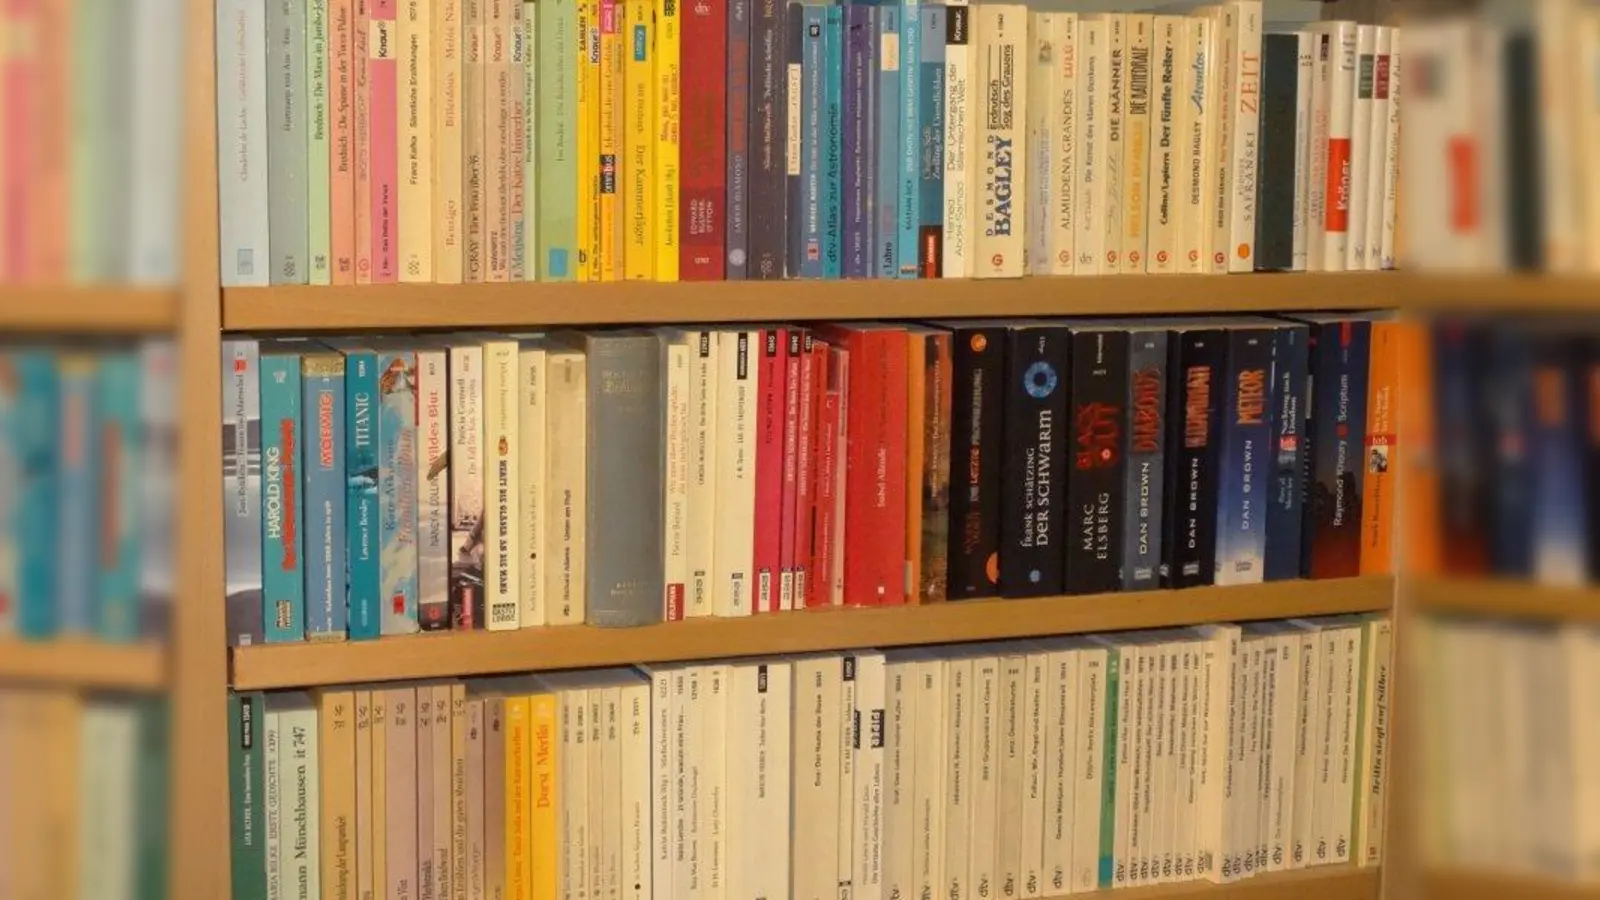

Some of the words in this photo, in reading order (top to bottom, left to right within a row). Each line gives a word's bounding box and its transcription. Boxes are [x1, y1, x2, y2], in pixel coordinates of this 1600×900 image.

[410, 34, 418, 85] Erzählungen
[948, 63, 956, 80] der
[1002, 44, 1011, 87] Grauens
[1162, 47, 1173, 83] Reiter
[957, 79, 965, 102] Welt
[1108, 48, 1122, 113] MÄNNER
[1240, 51, 1258, 113] ZEIT
[947, 84, 957, 146] Untergang
[990, 80, 999, 129] Erdrutsch
[1001, 91, 1009, 108] des
[1160, 86, 1172, 122] fünfte
[1001, 111, 1012, 129] Sog
[1062, 90, 1072, 153] GRANDES
[1086, 124, 1094, 138] des
[1109, 116, 1119, 141] DIE
[1160, 125, 1171, 147] Der
[828, 103, 837, 178] Astronomie
[1193, 122, 1201, 155] BAGLEY
[604, 156, 613, 192] omnibus
[947, 149, 956, 171] Der
[1244, 132, 1254, 221] SAFRANSKI
[829, 182, 837, 201] zur
[986, 135, 994, 236] DESMOND
[994, 136, 1011, 236] BAGLEY
[1061, 155, 1072, 230] ALMUDENA
[1160, 152, 1170, 224] Collins/Lapierre
[1191, 158, 1200, 204] DESMOND
[1337, 160, 1351, 210] Kröner
[470, 239, 478, 272] GRAY
[884, 242, 892, 268] Labro
[429, 390, 438, 418] Blut
[1236, 370, 1265, 424] METEOR
[1339, 374, 1350, 421] Scriptum
[320, 393, 333, 465] MOEWIG
[356, 393, 368, 447] TITANIC
[429, 422, 438, 464] Wildes
[1335, 440, 1347, 474] Khoury
[268, 447, 280, 480] KING
[877, 448, 886, 480] Allende
[1243, 440, 1253, 493] BROWN
[877, 483, 886, 507] Isabel
[1140, 462, 1150, 517] BROWN
[1190, 458, 1199, 511] BROWN
[268, 483, 281, 538] HAROLD
[1242, 500, 1251, 530] DAN
[1333, 479, 1345, 525] Raymond
[1083, 504, 1094, 551] MARC
[1097, 492, 1110, 559] ELSBERG
[1139, 523, 1148, 555] DAN
[1188, 518, 1196, 548] DAN
[360, 528, 369, 560] Lawrence
[293, 726, 306, 747] 747
[294, 748, 306, 758] it
[536, 725, 549, 765] Merlin
[293, 766, 306, 859] Münchhausen
[1273, 846, 1282, 864] dtv
[1293, 844, 1303, 862] dtv
[1316, 841, 1326, 858] dtv
[1336, 839, 1346, 856] dtv
[1026, 874, 1036, 893] dtv
[1053, 870, 1063, 888] dtv
[1116, 864, 1124, 881] dtv
[1223, 858, 1231, 877] dtv
[979, 878, 989, 897] dtv
[1003, 877, 1014, 896] dtv
